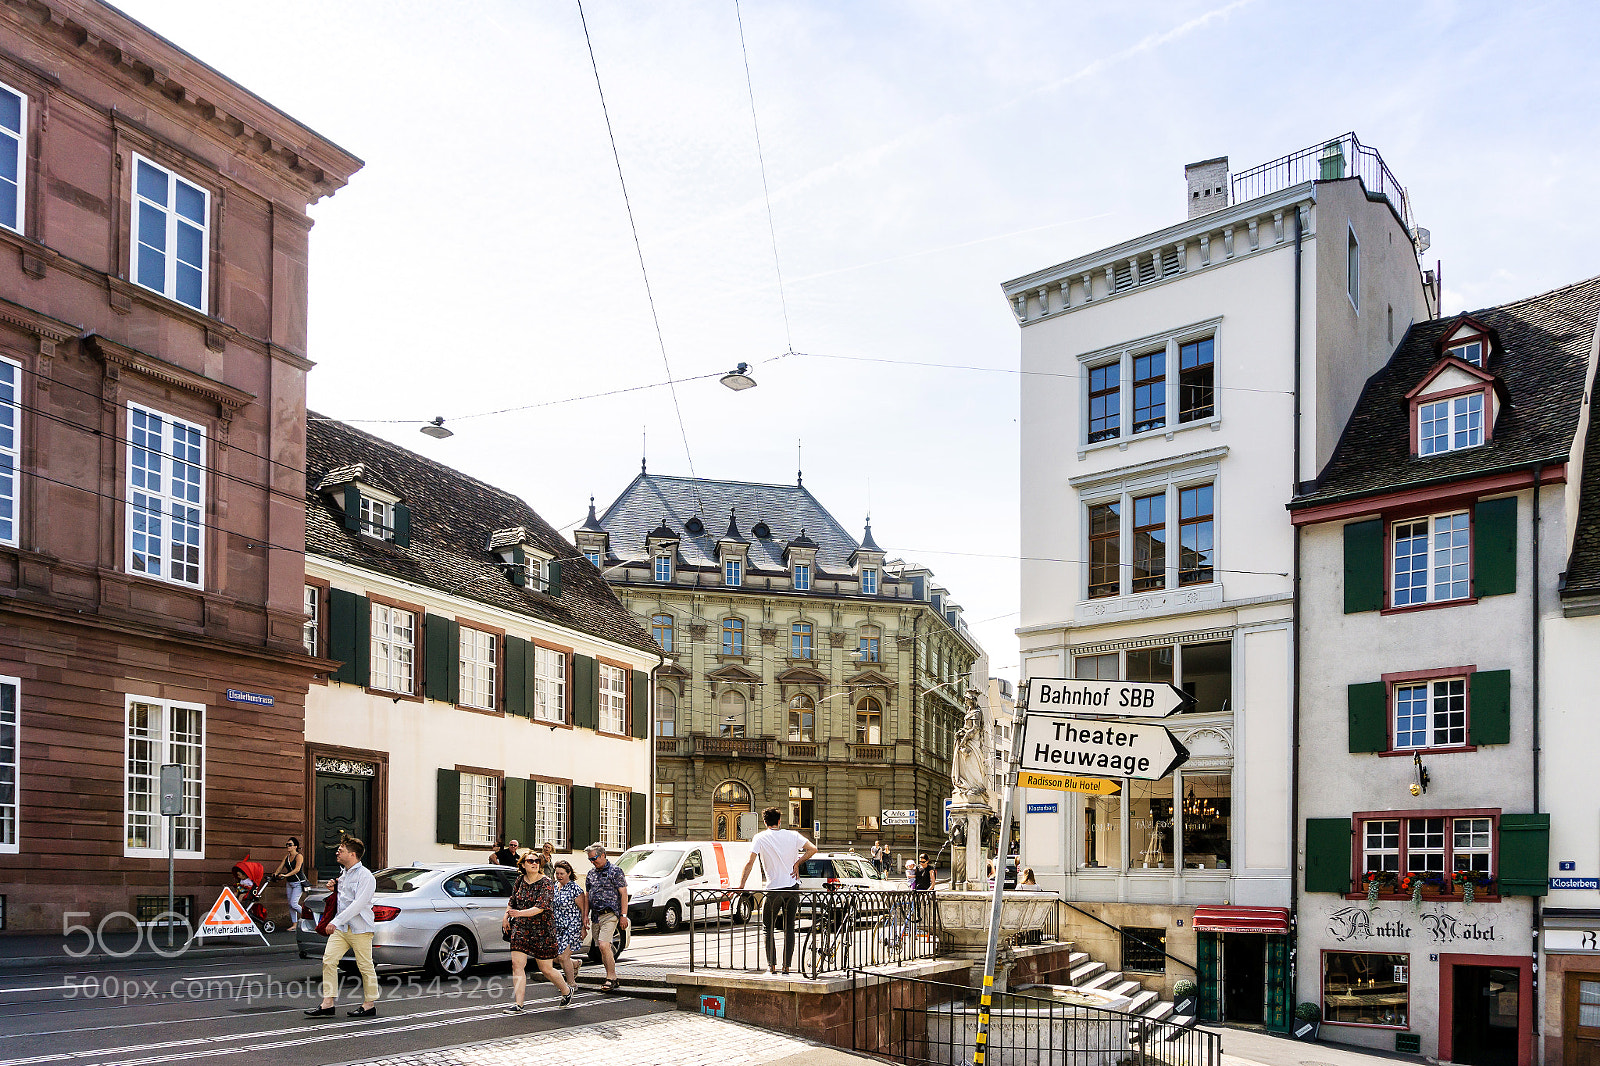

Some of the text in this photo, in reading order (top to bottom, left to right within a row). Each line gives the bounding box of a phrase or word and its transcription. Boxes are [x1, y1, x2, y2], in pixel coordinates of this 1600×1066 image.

[1039, 684, 1155, 708] Bahnhof SBB
[1052, 721, 1139, 748] Theater
[1034, 742, 1150, 775] Heuwaage
[1027, 776, 1101, 791] Radisson Blu Hotel
[1552, 878, 1597, 889] Klosterberg
[202, 925, 255, 934] Verkehrsdienst
[1329, 906, 1413, 942] Antike
[1420, 910, 1497, 943] Möbel
